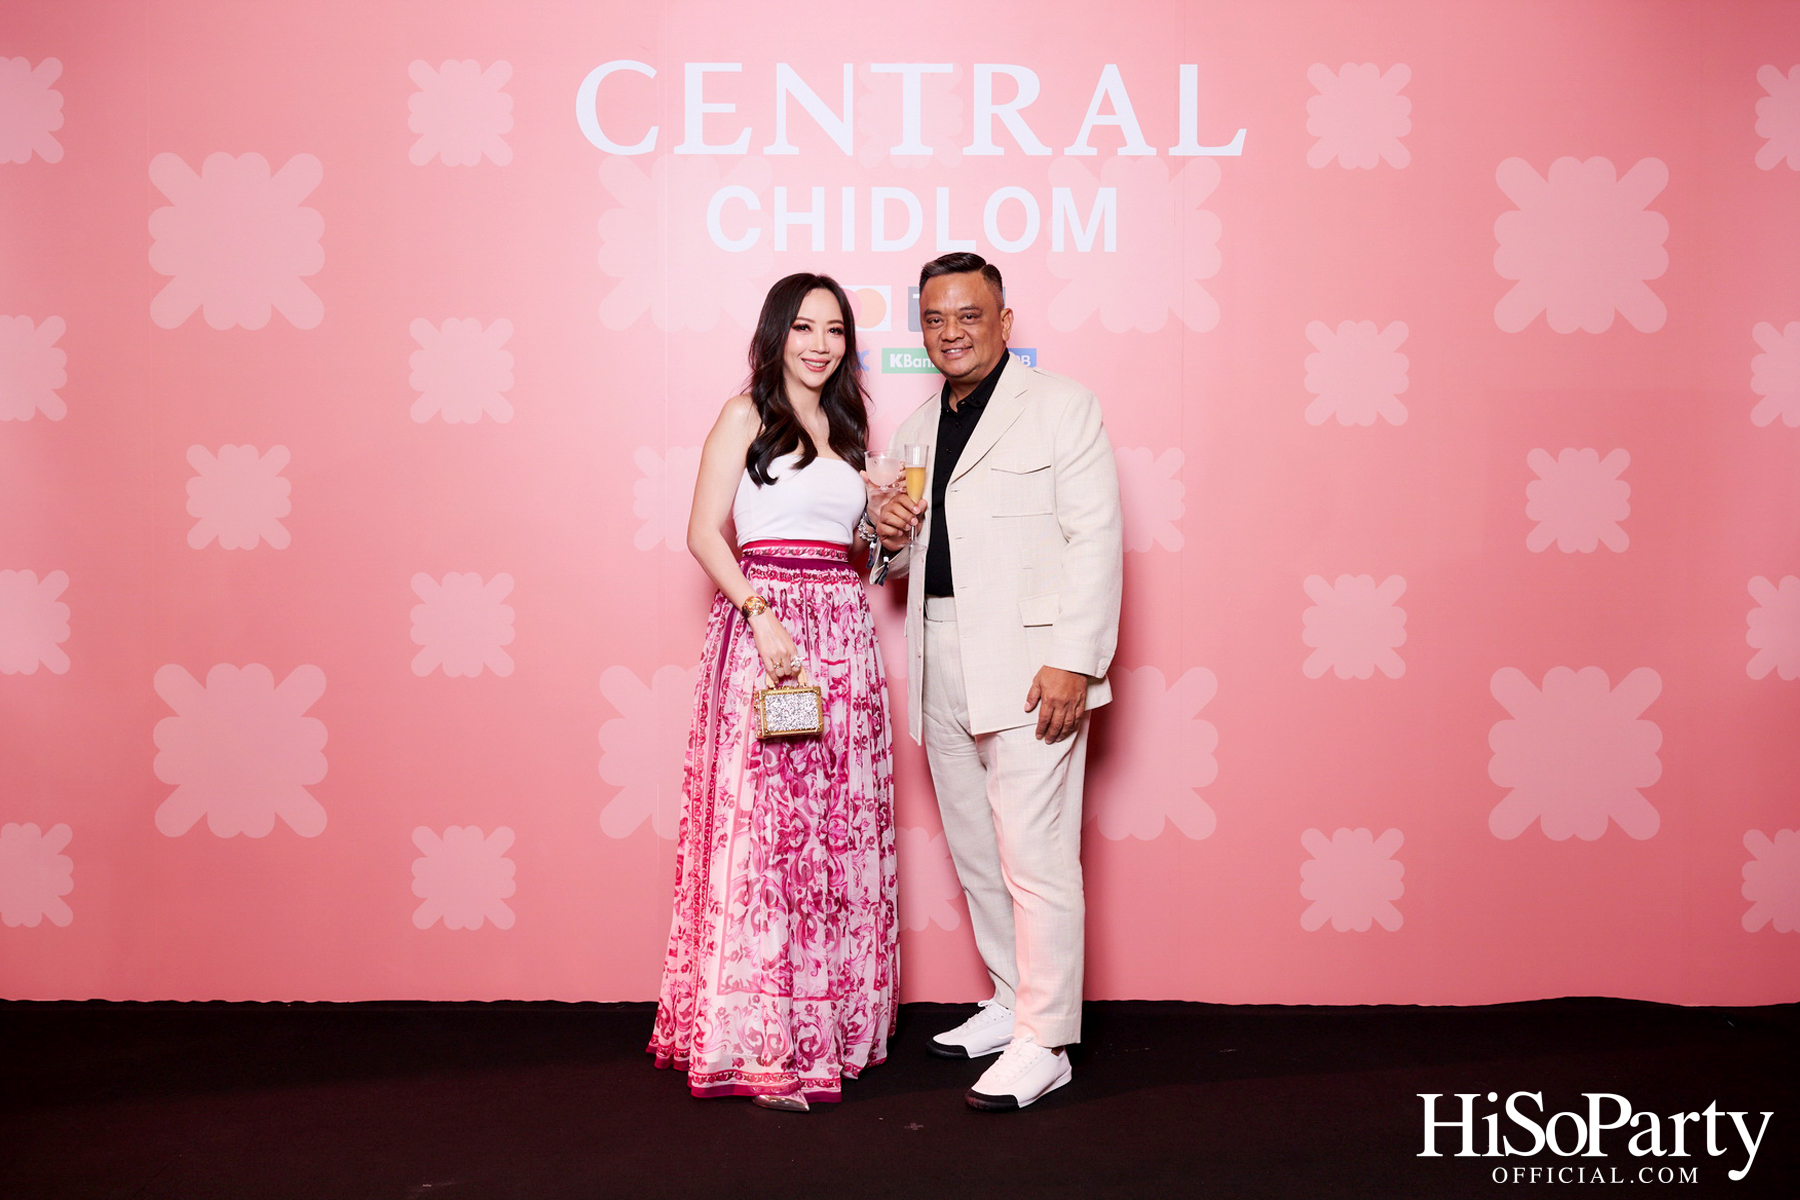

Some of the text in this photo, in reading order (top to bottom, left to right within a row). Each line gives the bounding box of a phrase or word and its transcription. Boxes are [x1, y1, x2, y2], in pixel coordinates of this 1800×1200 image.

[575, 59, 1247, 157] CENTRAL
[706, 184, 1118, 253] CHIDLOM
[890, 353, 936, 368] KBan
